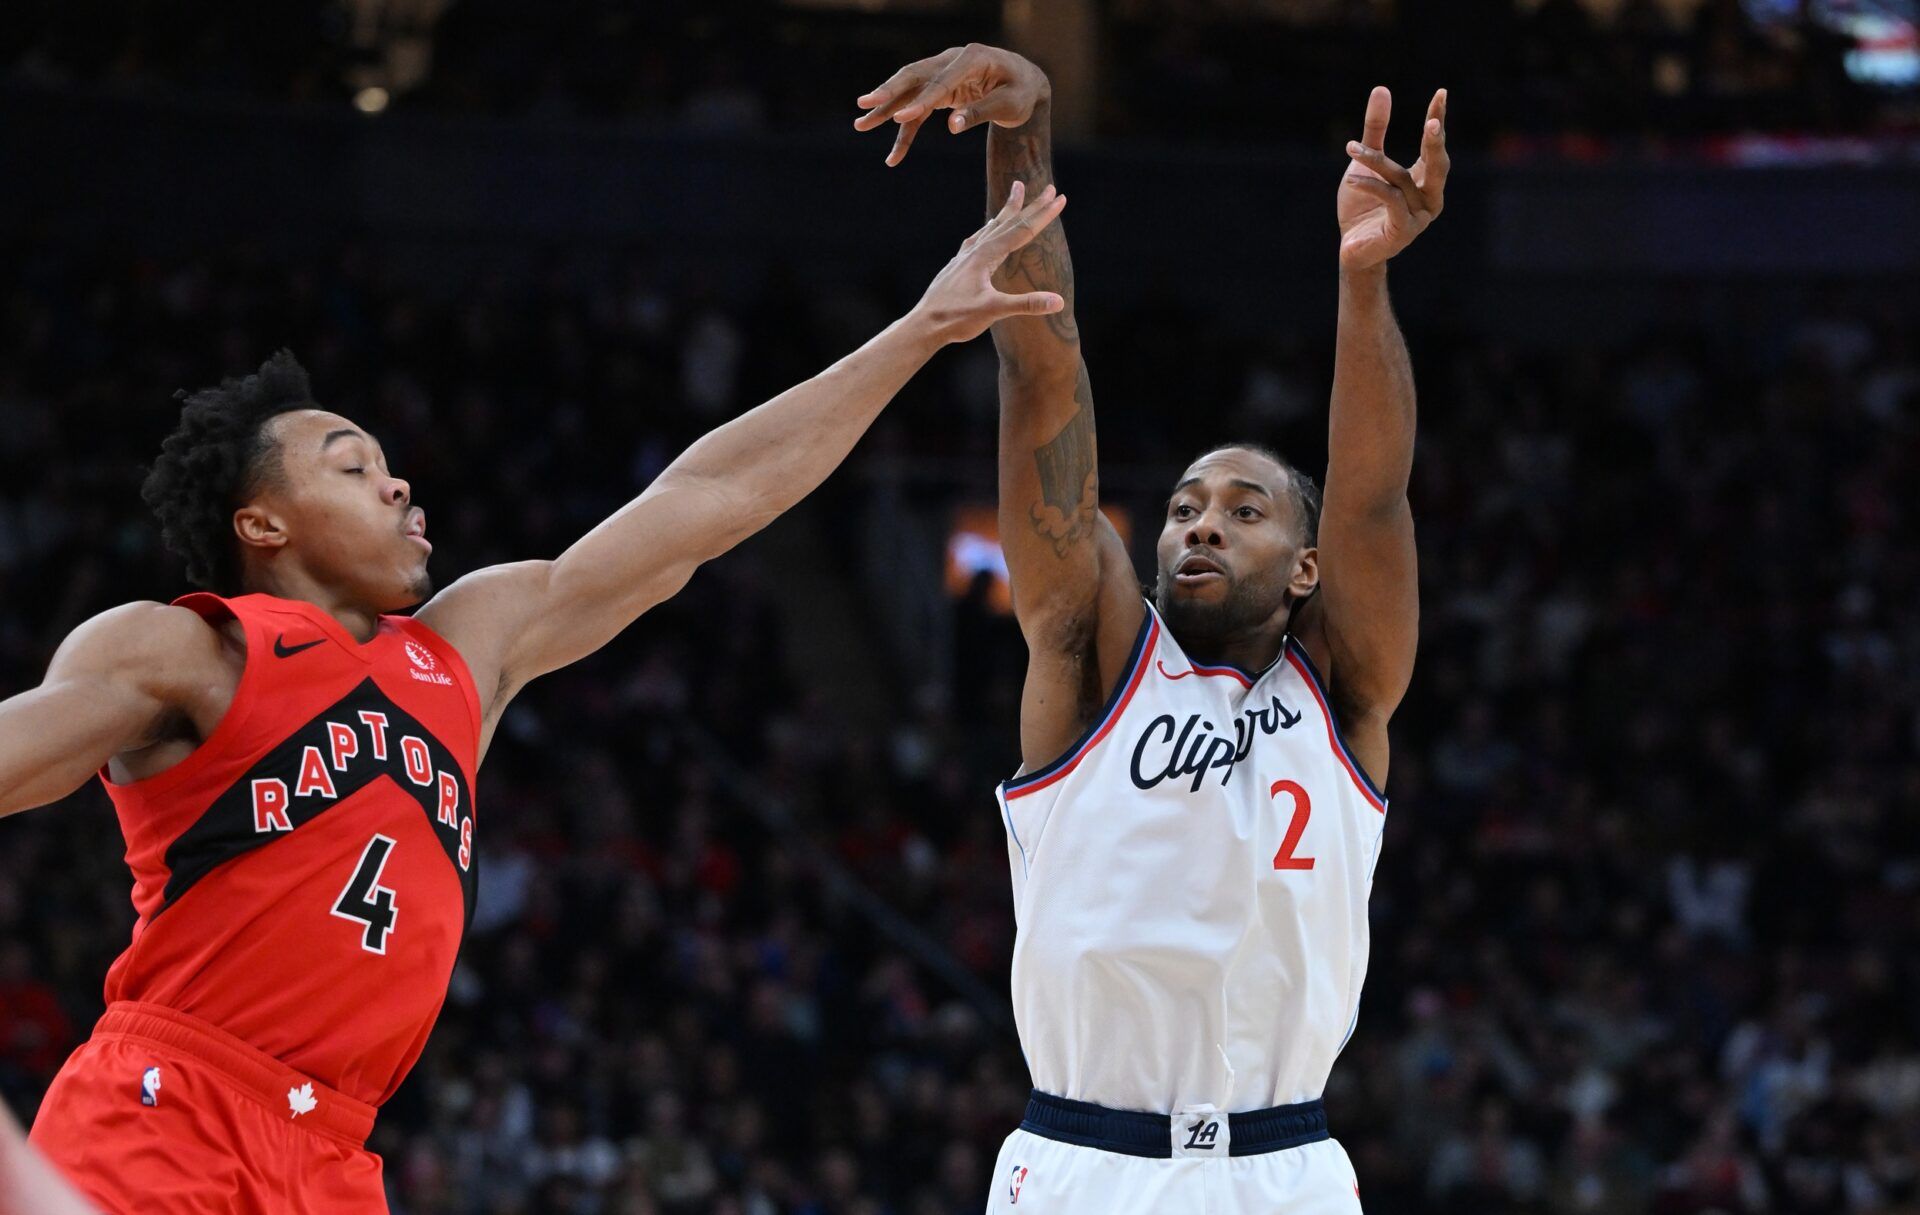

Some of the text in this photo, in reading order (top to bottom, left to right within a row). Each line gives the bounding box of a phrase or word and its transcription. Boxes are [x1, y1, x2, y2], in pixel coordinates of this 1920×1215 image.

[410, 668, 452, 686] Sun Life
[251, 710, 472, 872] RAPTORS
[1270, 779, 1316, 870] 2
[329, 833, 398, 955] 4
[1184, 1119, 1219, 1150] LA
